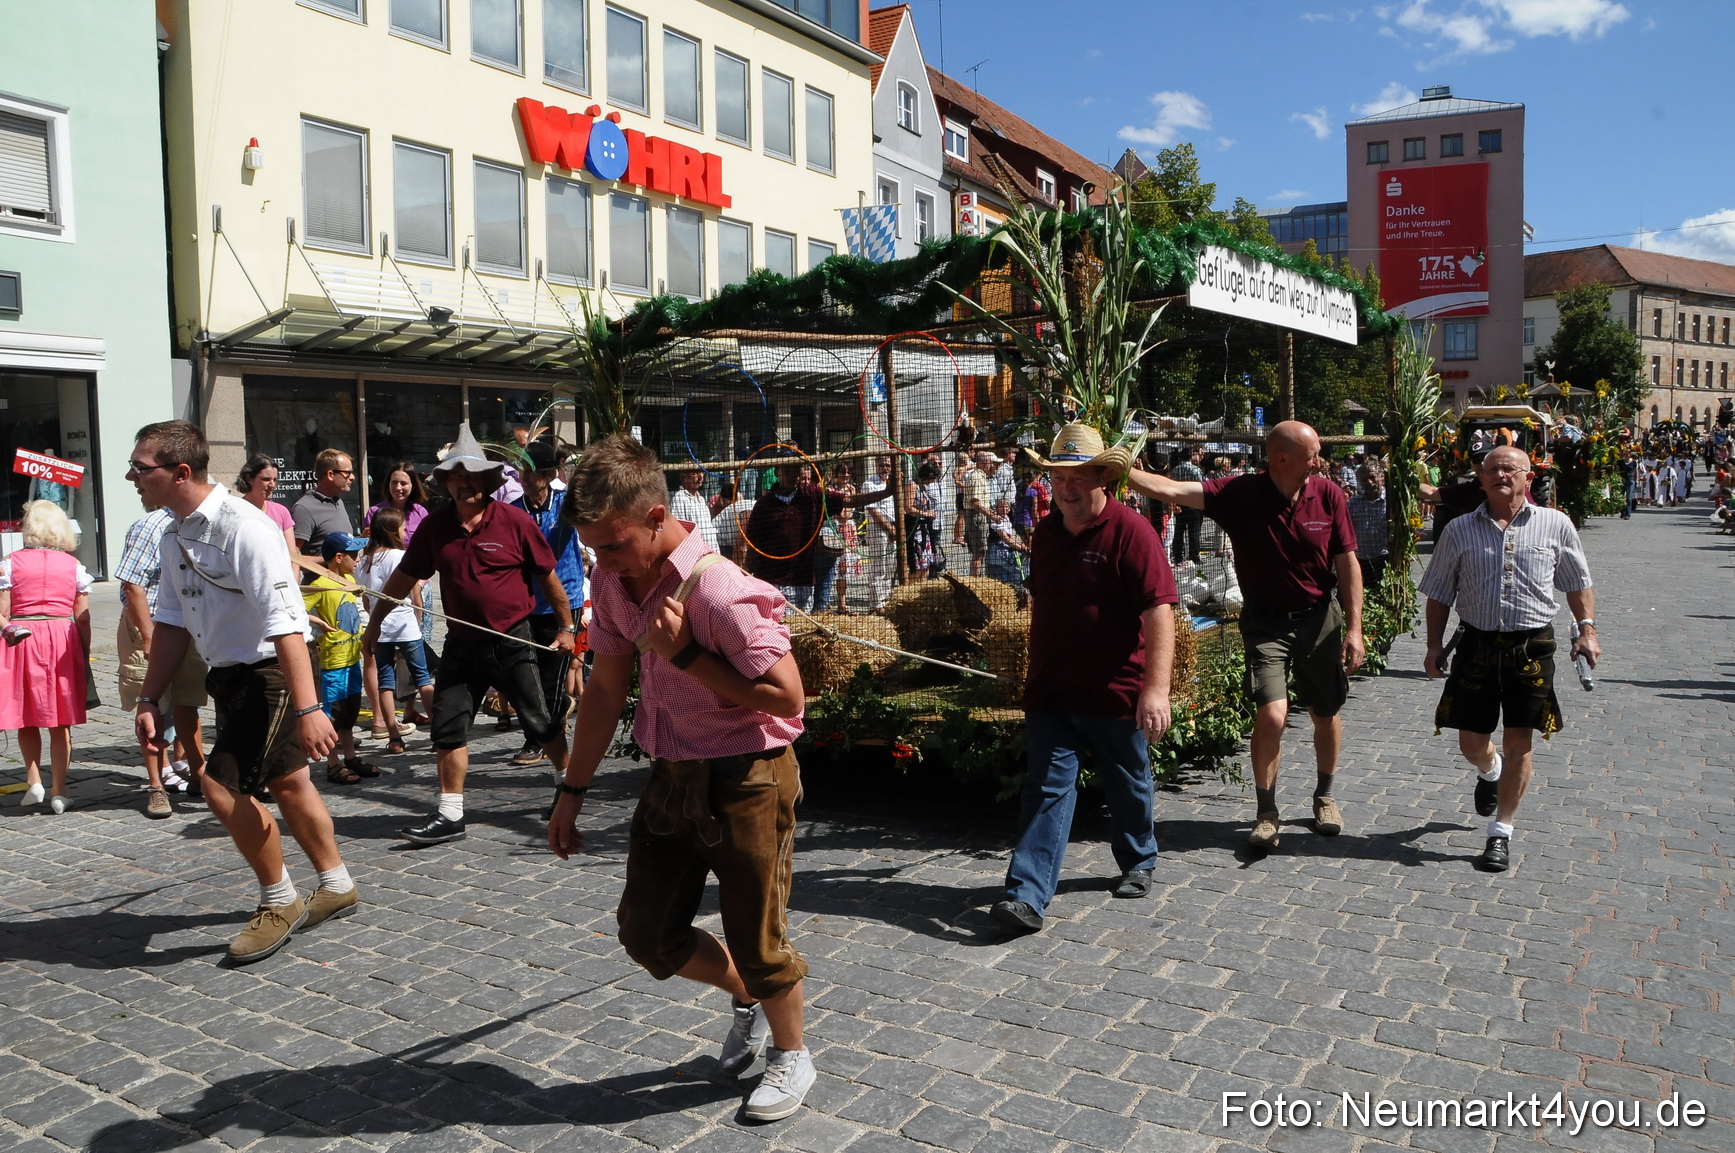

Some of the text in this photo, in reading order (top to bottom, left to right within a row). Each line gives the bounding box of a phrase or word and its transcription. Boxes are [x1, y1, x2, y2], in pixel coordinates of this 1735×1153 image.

[516, 96, 732, 209] WÖHRL
[1386, 204, 1425, 217] Danke
[1385, 221, 1397, 229] für
[1411, 219, 1451, 228] Vertrauen
[1386, 229, 1445, 240] und Ihre Treue.
[1418, 255, 1455, 271] 175
[1419, 270, 1455, 280] JAHRE
[1199, 250, 1352, 330] Geflügel auf dem Weg zur Olympiade
[21, 460, 53, 479] 10%
